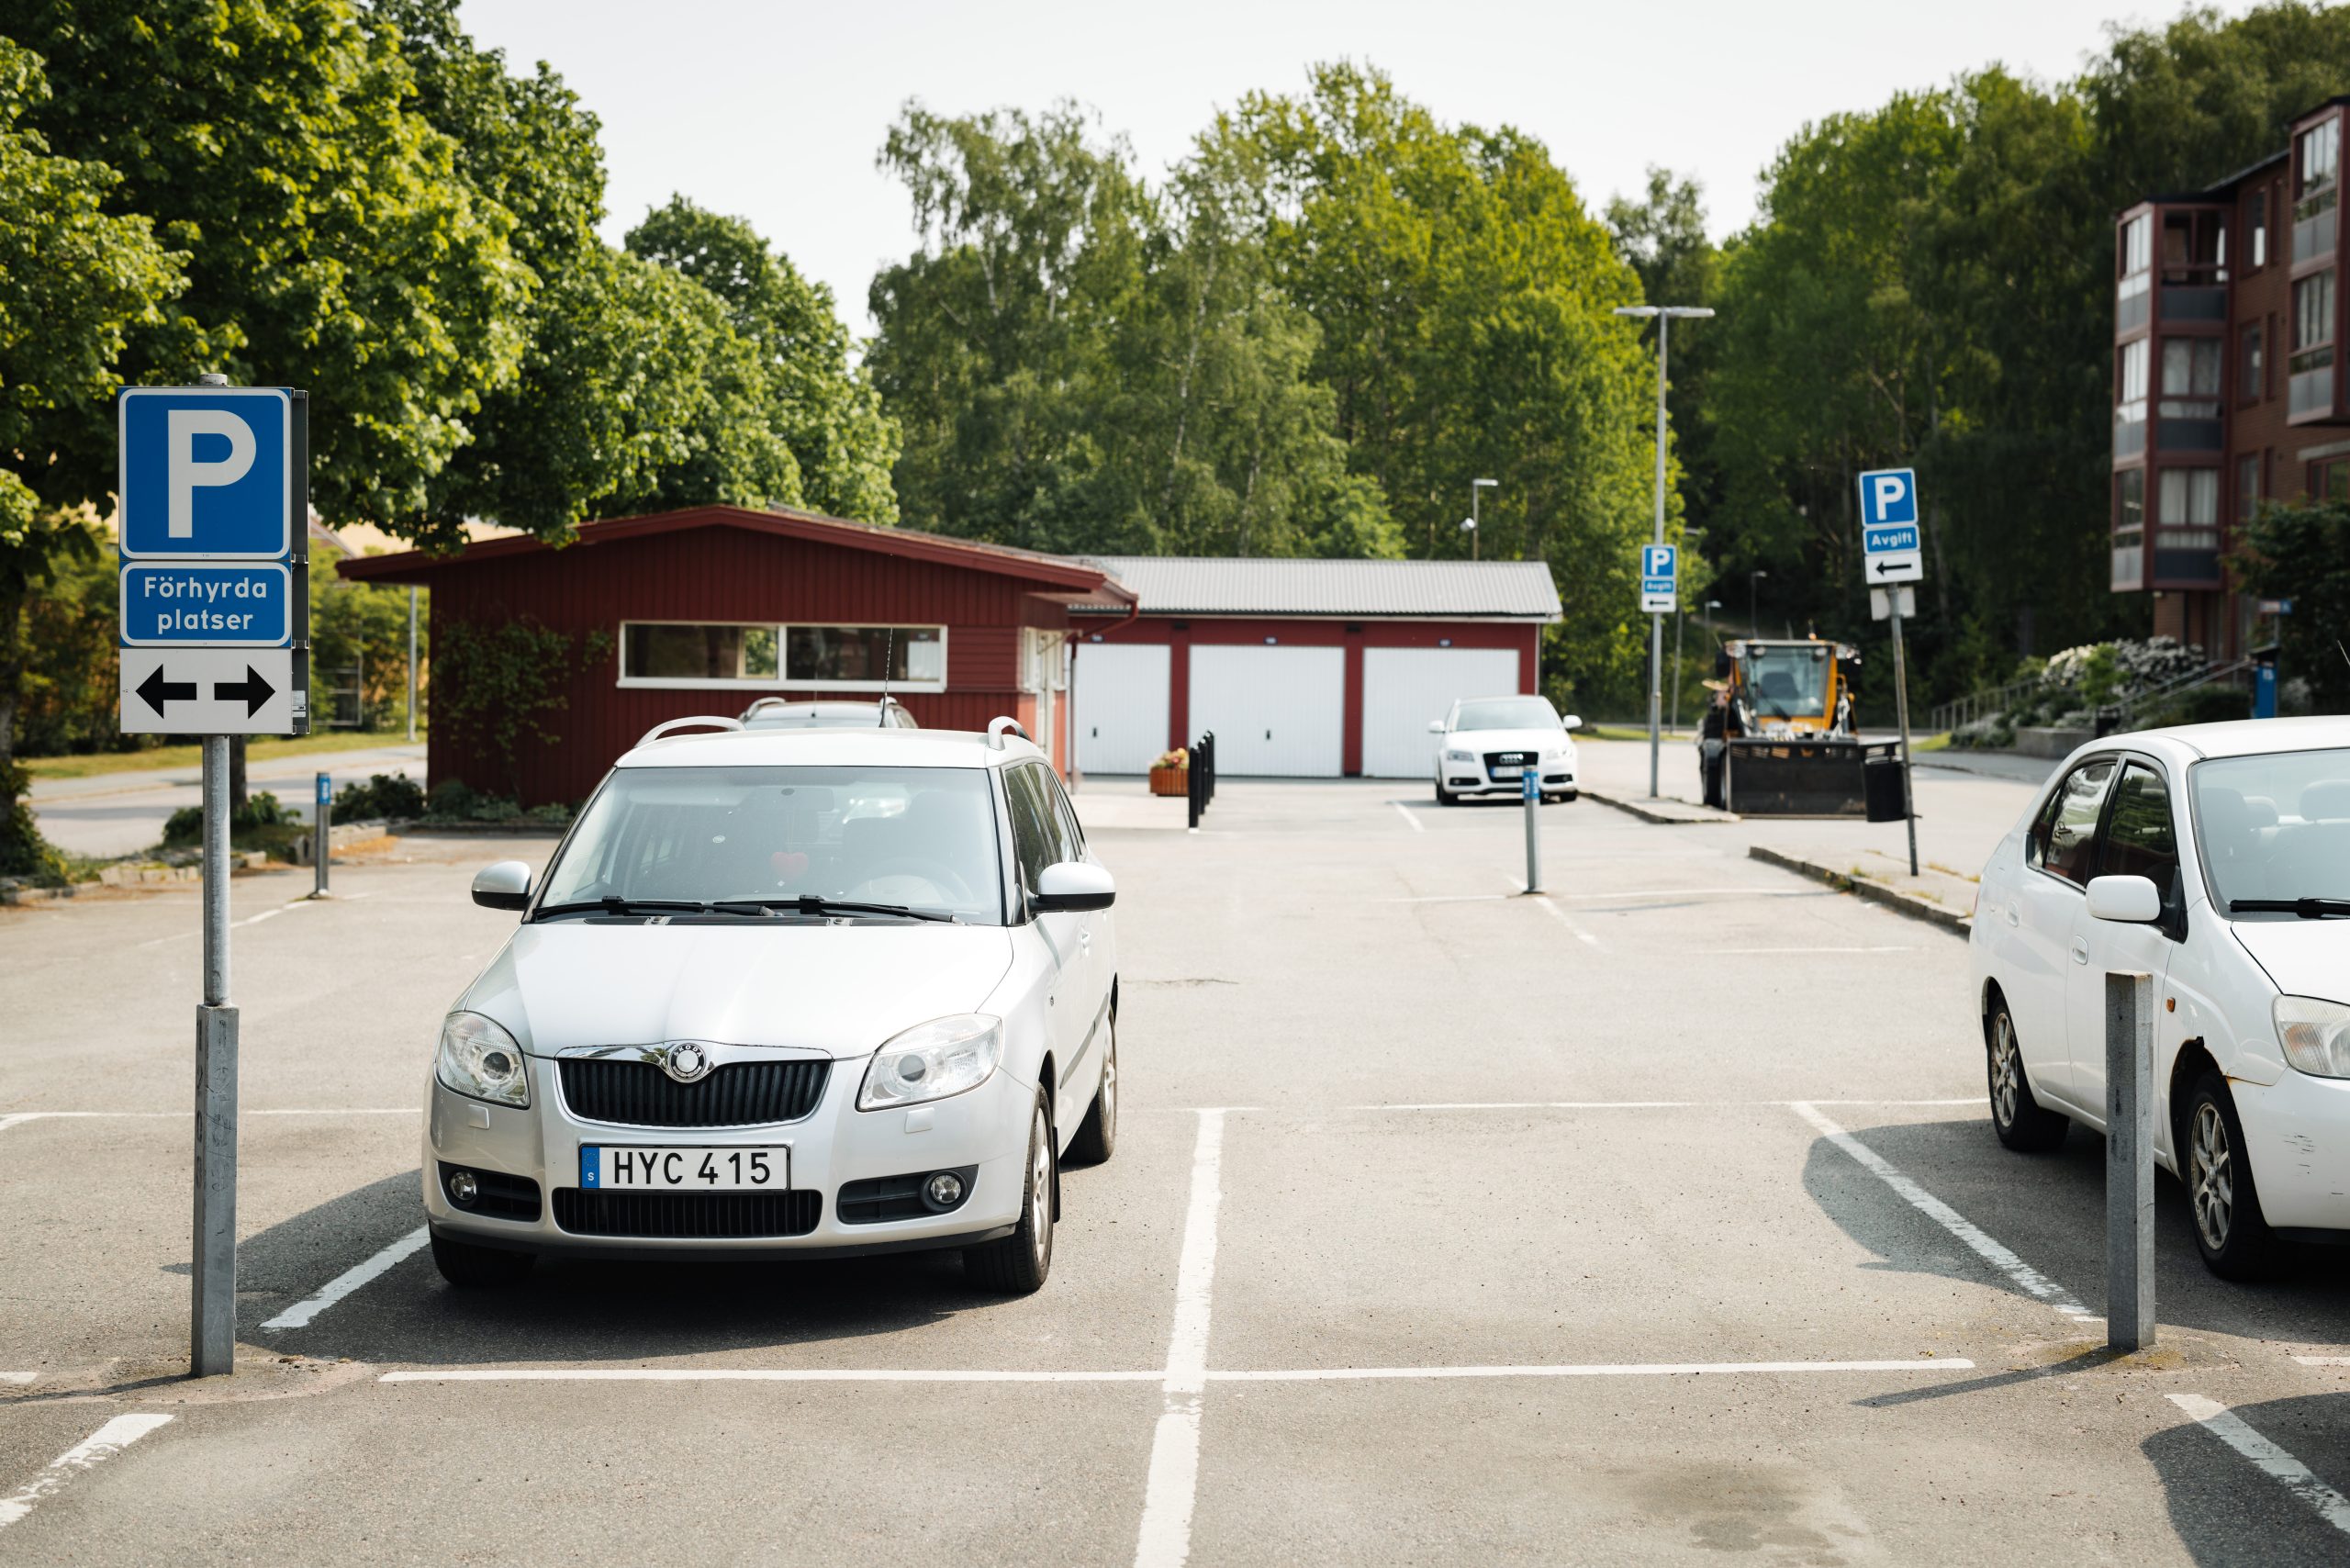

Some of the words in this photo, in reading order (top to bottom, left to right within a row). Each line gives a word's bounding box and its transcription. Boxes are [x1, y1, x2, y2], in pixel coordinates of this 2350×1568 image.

[168, 409, 257, 538] P
[1874, 476, 1906, 521] P
[1872, 532, 1912, 547] Avgift
[1651, 549, 1671, 576] P
[144, 577, 267, 603] Förhyrda
[158, 609, 253, 634] platser
[588, 1171, 595, 1182] S
[614, 1151, 683, 1185] HYC
[698, 1151, 770, 1185] 415
